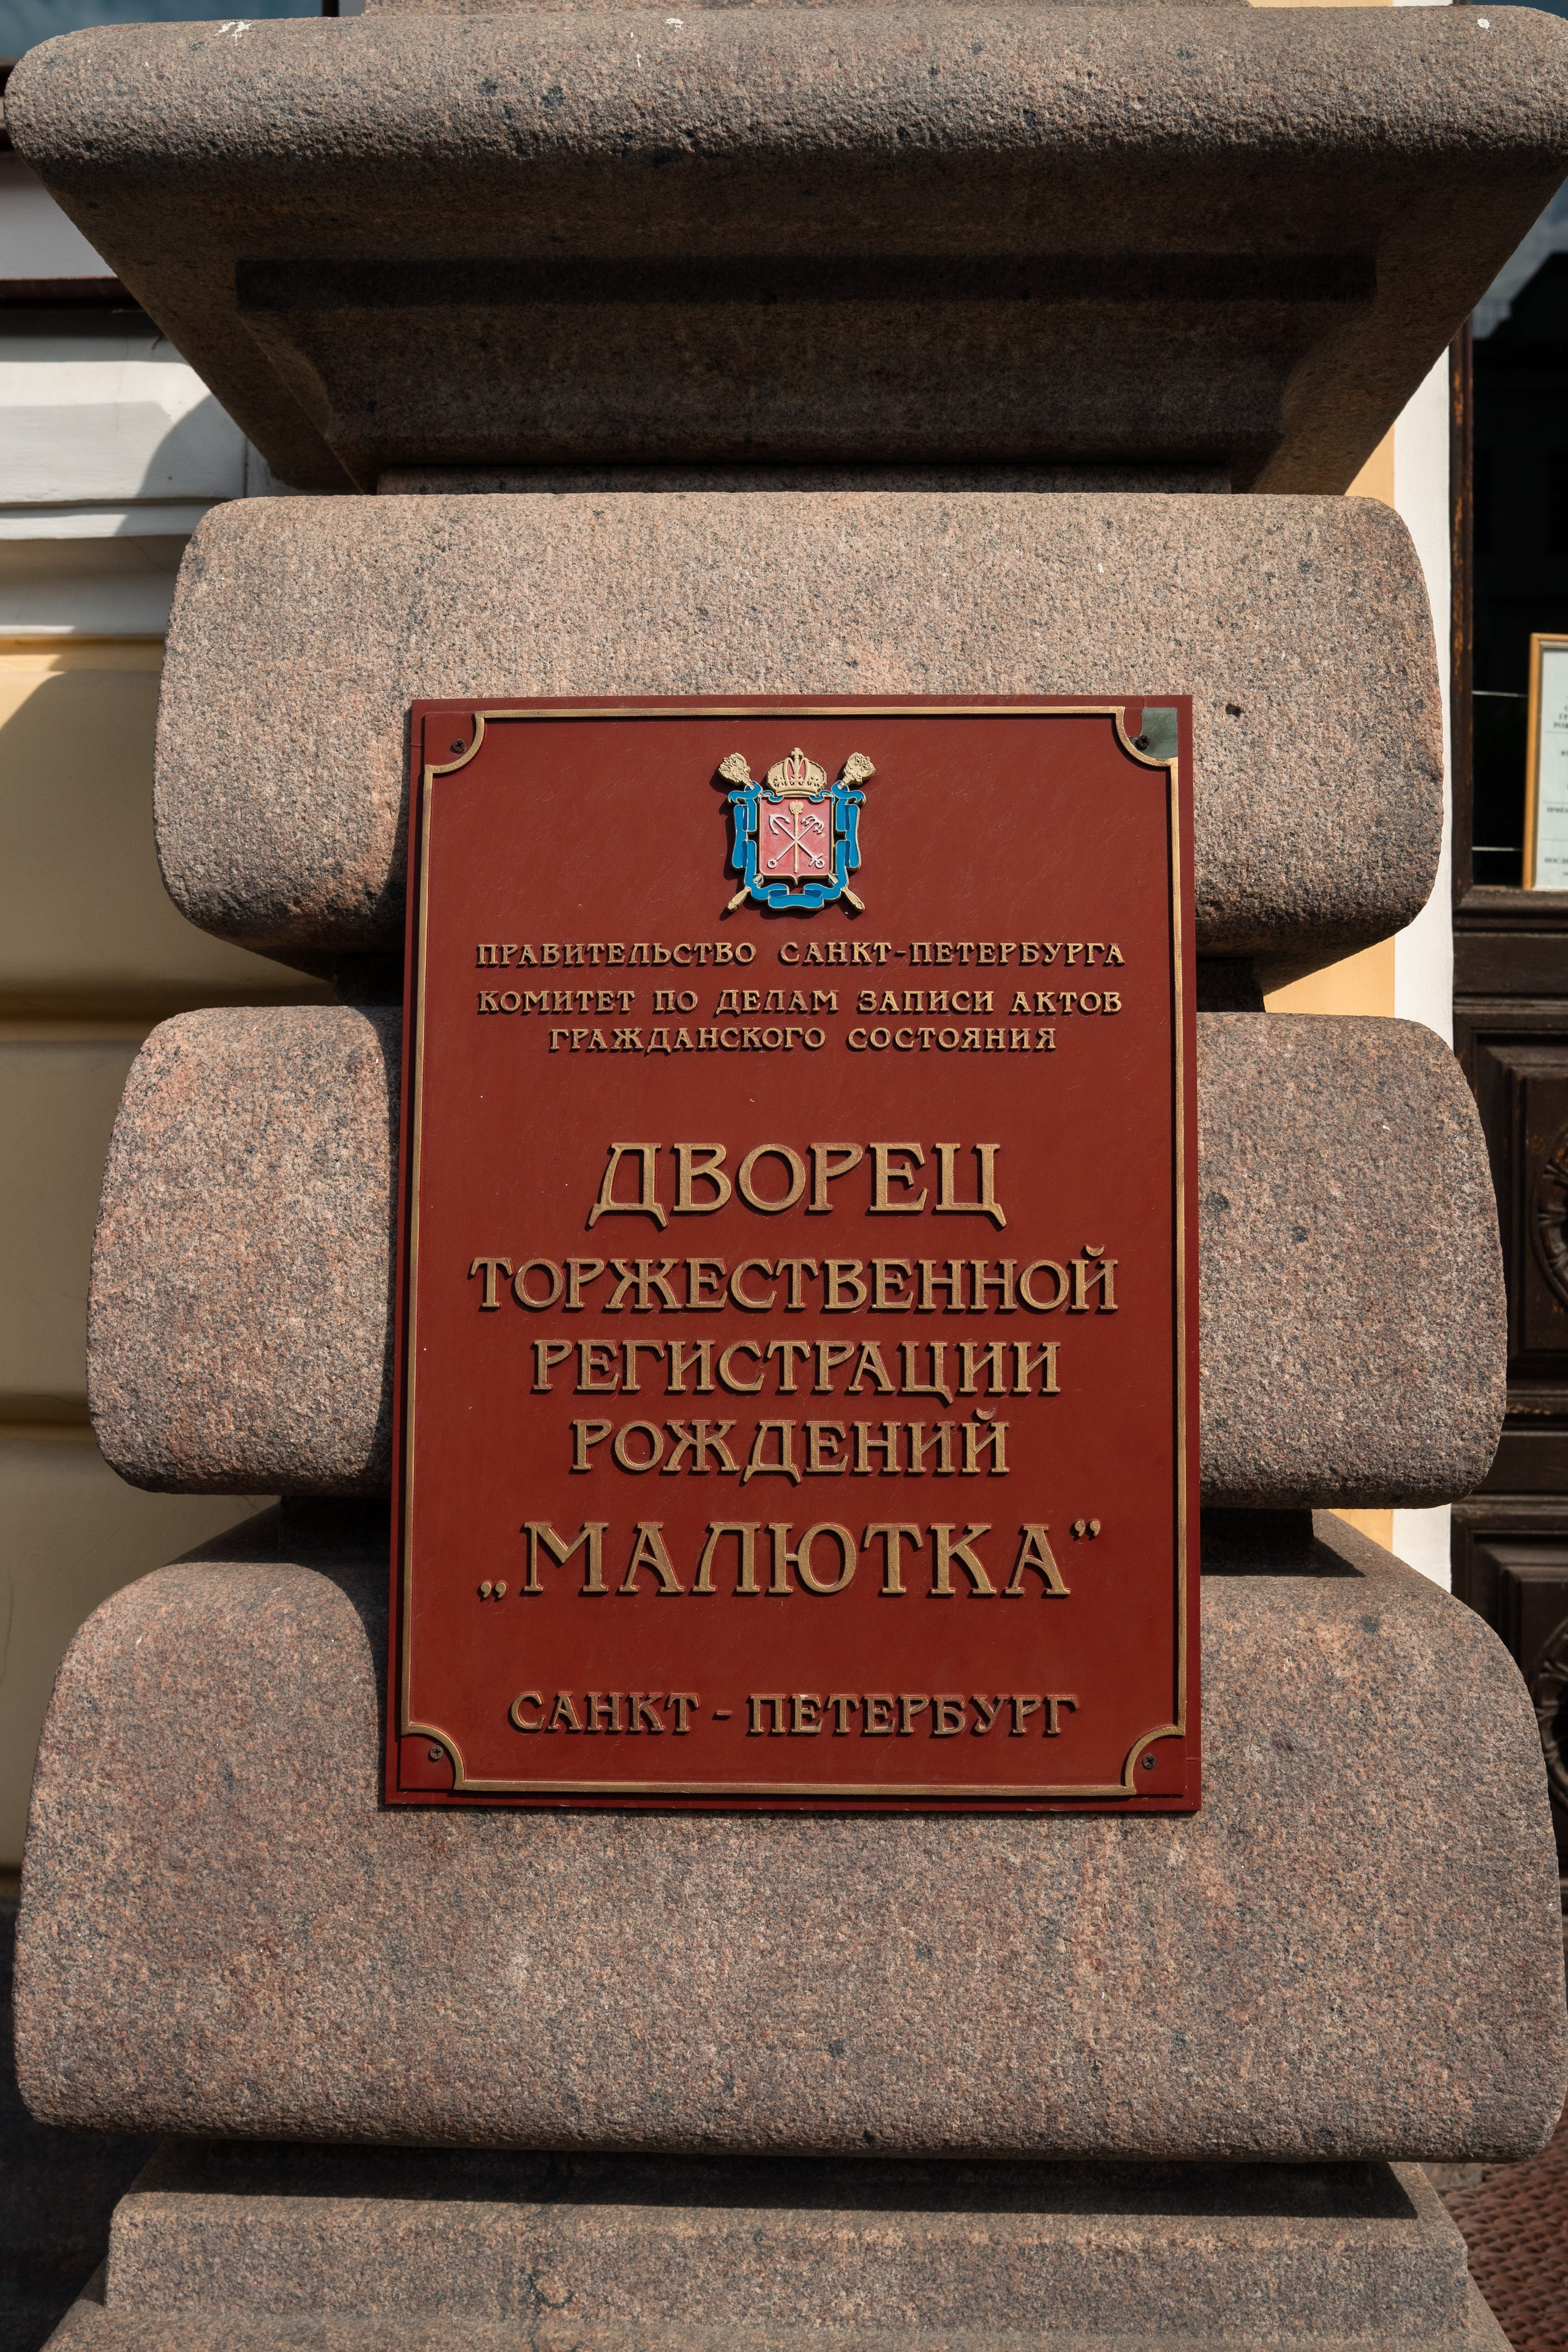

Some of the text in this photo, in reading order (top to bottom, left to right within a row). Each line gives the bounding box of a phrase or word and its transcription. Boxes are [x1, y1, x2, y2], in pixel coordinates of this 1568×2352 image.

[477, 941, 1126, 966] ПРАВИТЕЛЬСТВО САНКТ-ПЕТЕРБУРГА
[478, 990, 1123, 1016] КОМИТЕТ ПО ДЕЛАМ ЗАПИСИ АКТОВ
[549, 1027, 1057, 1054] ГРАЖДАНСКОГО СОСТОЯНИЯ
[588, 1142, 1006, 1227] ДВОРЕЦ
[469, 1245, 1118, 1311] ТОРЖЕСТВЕННОЙ
[532, 1339, 1061, 1404] РЕГИСТРАЦИИ
[570, 1409, 1011, 1483] РОЖДЕНИЙ
[510, 1692, 699, 1734] САНКТ
[748, 1693, 1079, 1735] ПЕТЕРБУРГ
